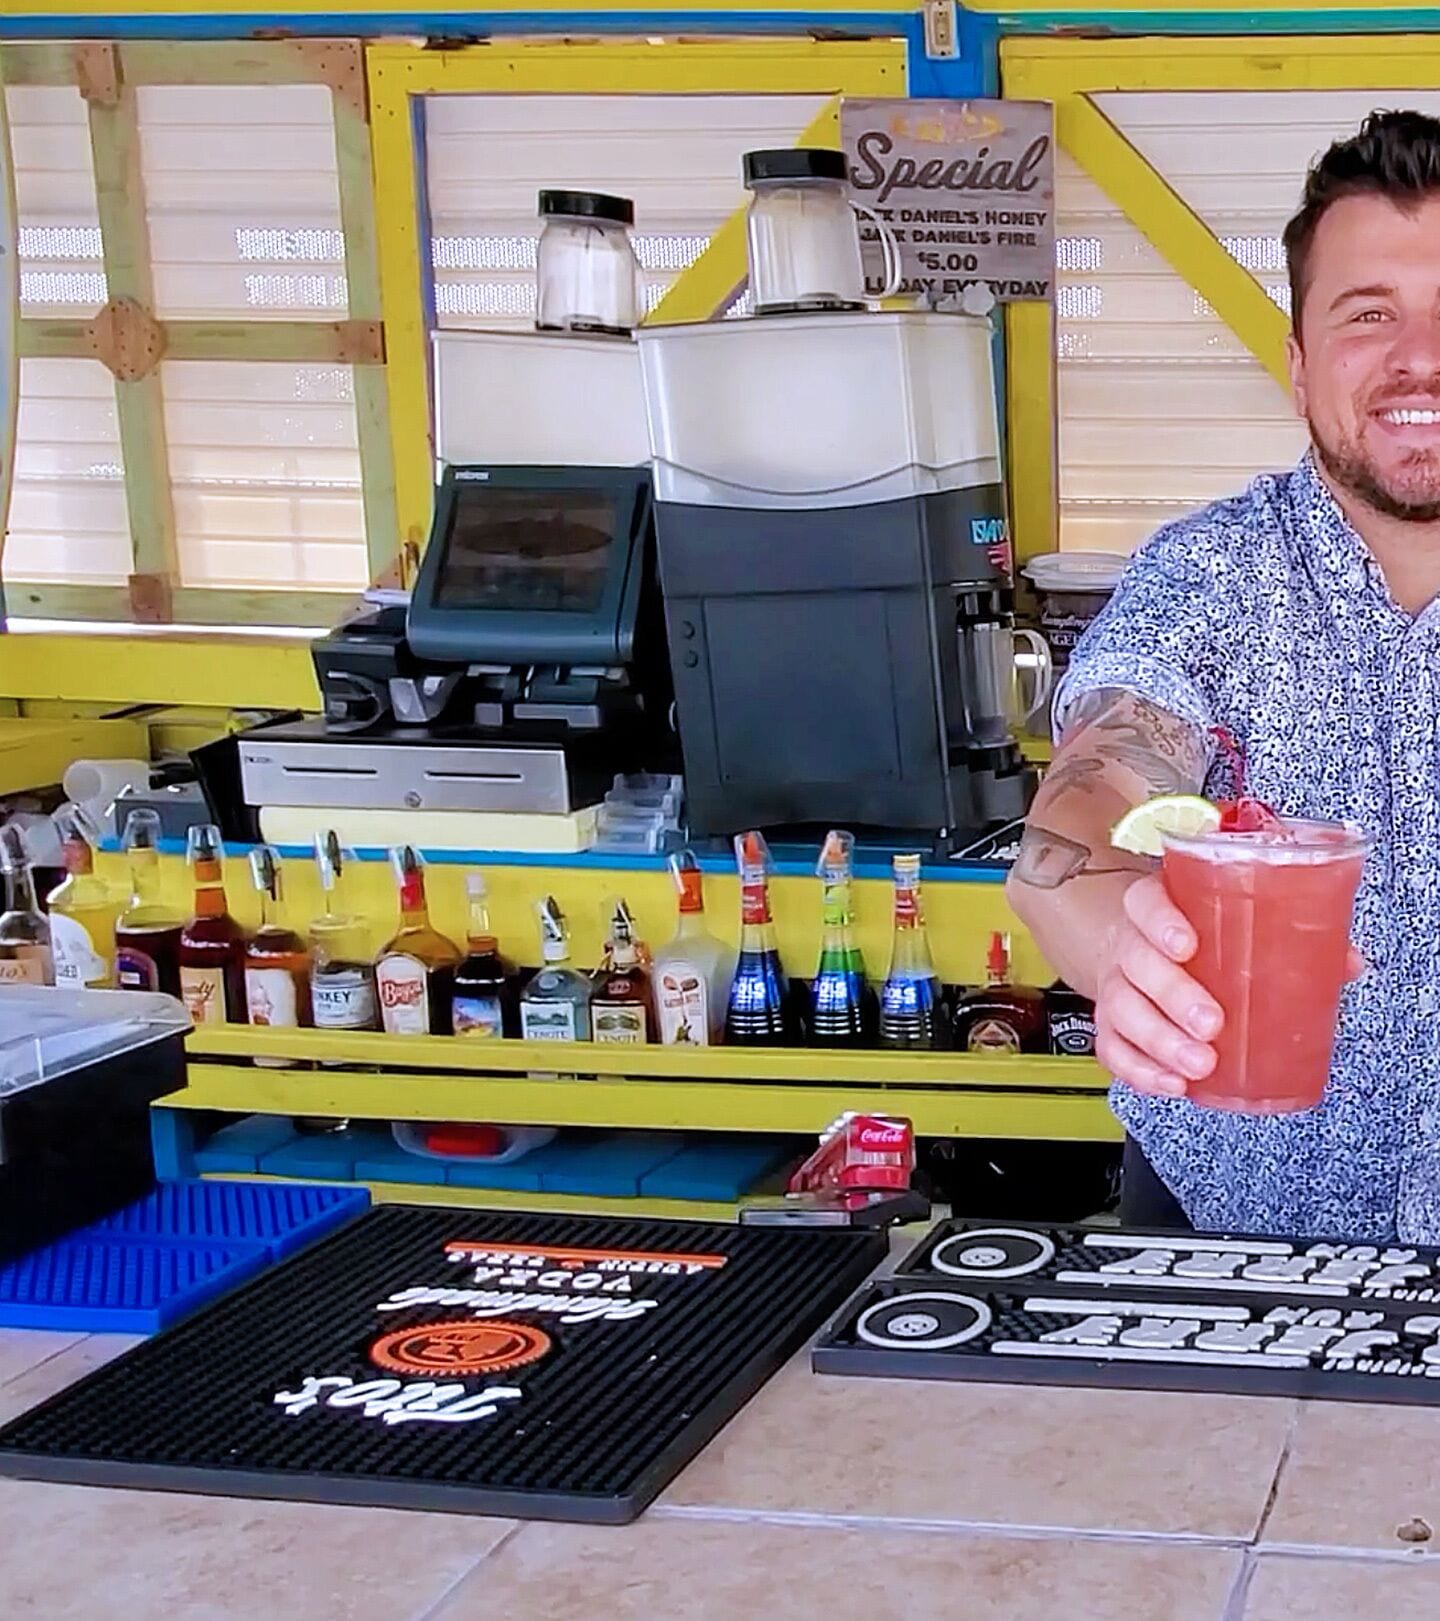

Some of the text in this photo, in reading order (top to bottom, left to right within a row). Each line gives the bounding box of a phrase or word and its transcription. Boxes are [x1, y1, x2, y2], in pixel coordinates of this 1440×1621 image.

[851, 132, 1050, 203] Special
[900, 208, 980, 225] DANIEL'S
[985, 210, 1048, 226] HONEY
[912, 229, 991, 245] DANIEL'S
[997, 231, 1037, 246] FIRE
[918, 251, 978, 271] $5.00
[1305, 1242, 1418, 1264] RUM
[474, 1266, 633, 1292] VODKA
[1099, 1249, 1431, 1289] JERRY
[1263, 1306, 1385, 1329] RUM
[1039, 1315, 1399, 1358] JERRY
